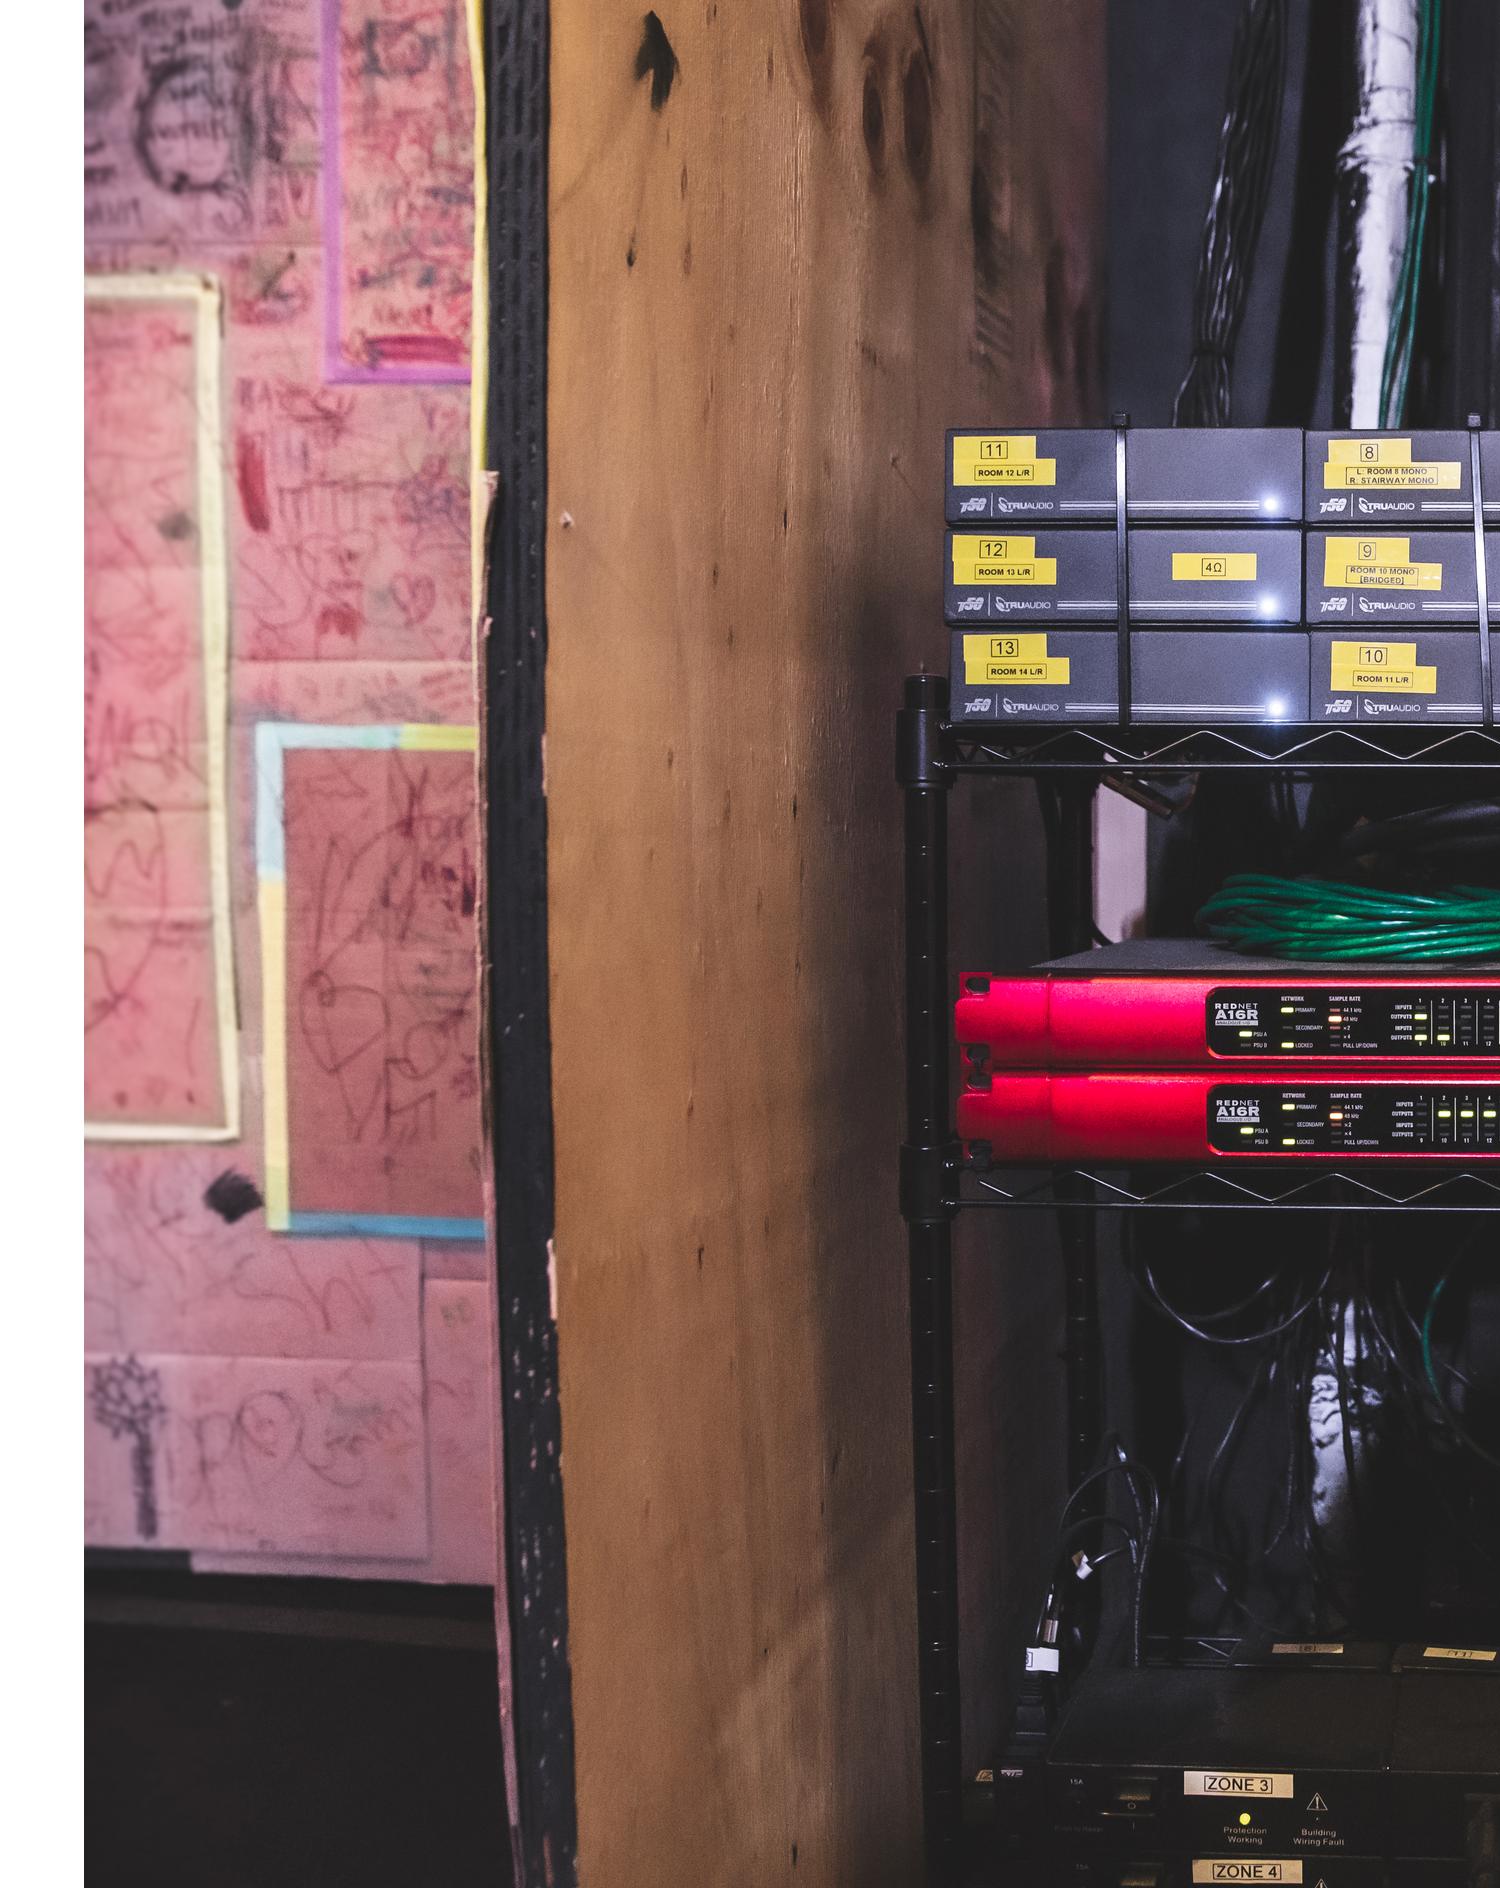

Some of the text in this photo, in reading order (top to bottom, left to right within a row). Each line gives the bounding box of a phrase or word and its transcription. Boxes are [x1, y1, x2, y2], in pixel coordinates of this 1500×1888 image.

[985, 444, 1002, 456] 11
[1365, 446, 1374, 460] 8
[1367, 502, 1415, 510] TRUAUDIO
[985, 544, 1003, 557] 12
[1363, 544, 1372, 558] 9
[1205, 562, 1223, 573] 4Ω
[1004, 601, 1051, 609] TRUAUDIO
[1367, 602, 1416, 610] TRUAUDIO
[996, 641, 1014, 655] 13
[1365, 650, 1383, 663] 10
[1373, 704, 1420, 712] TRUAUDIO
[1216, 1010, 1258, 1020] A16R
[1217, 1106, 1260, 1116] A16R
[1208, 1778, 1268, 1792] ZONE 3
[1223, 1826, 1267, 1835] Protection
[1301, 1828, 1337, 1838] Building
[1228, 1836, 1263, 1845] Working
[1293, 1837, 1345, 1847] Wiring Fault
[1216, 1865, 1277, 1879] ZONE 4
